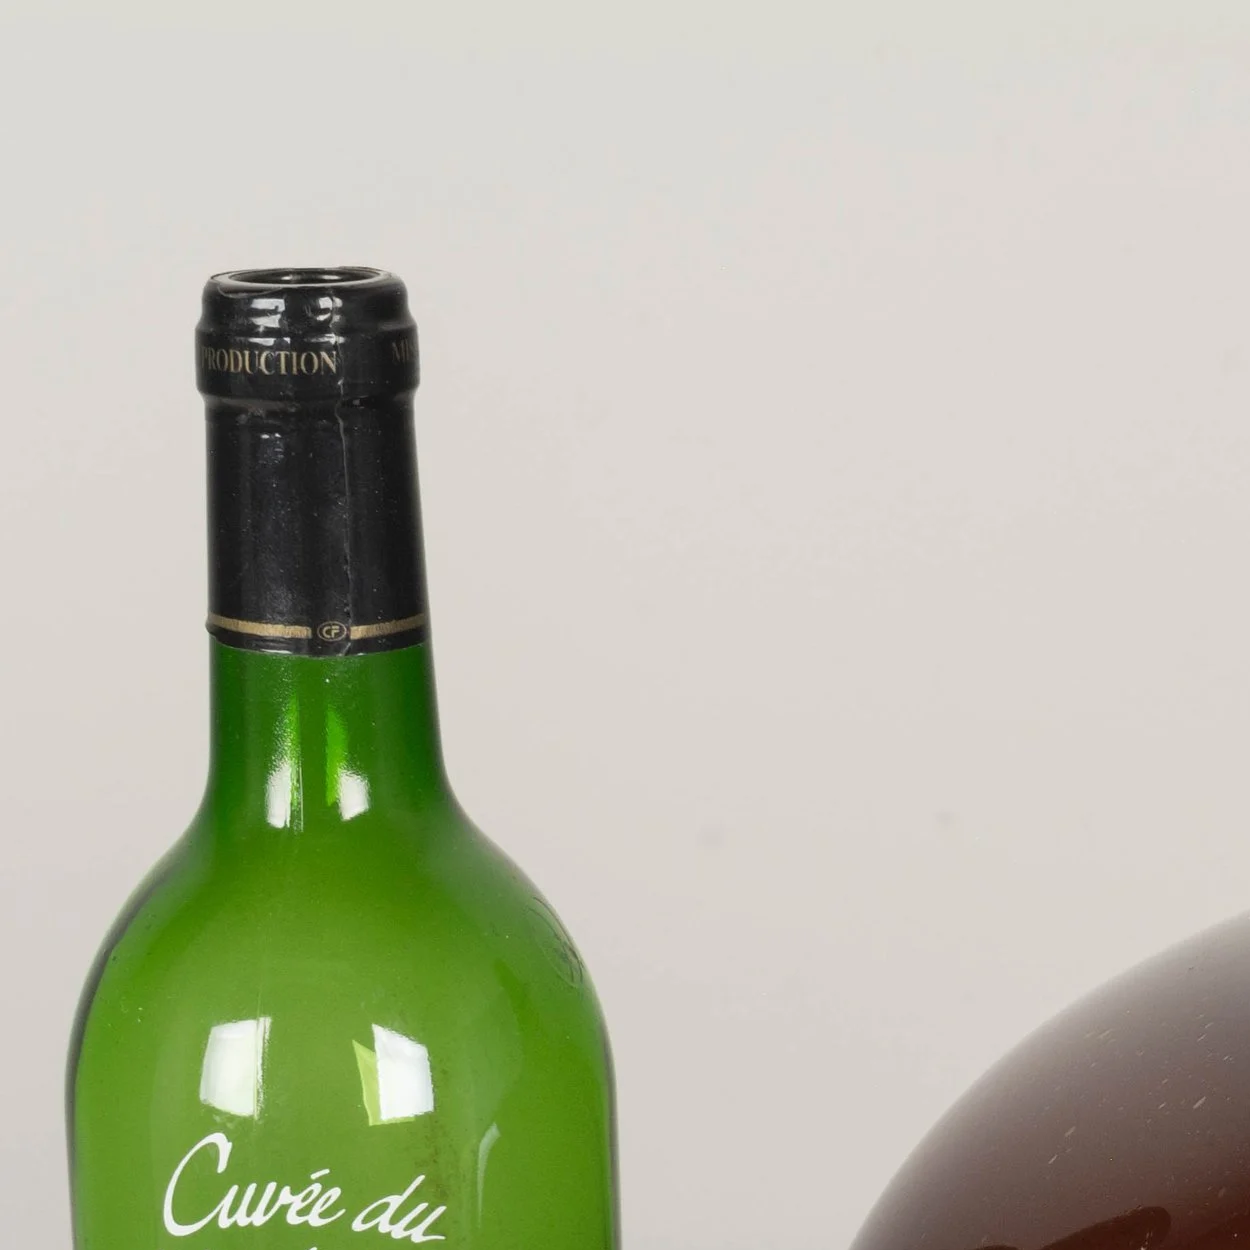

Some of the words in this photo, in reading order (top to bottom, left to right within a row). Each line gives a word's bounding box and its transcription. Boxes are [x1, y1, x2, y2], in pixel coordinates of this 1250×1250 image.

[200, 346, 337, 376] PRODUCTION
[163, 1132, 346, 1236] Cuvée
[351, 1174, 446, 1243] du
